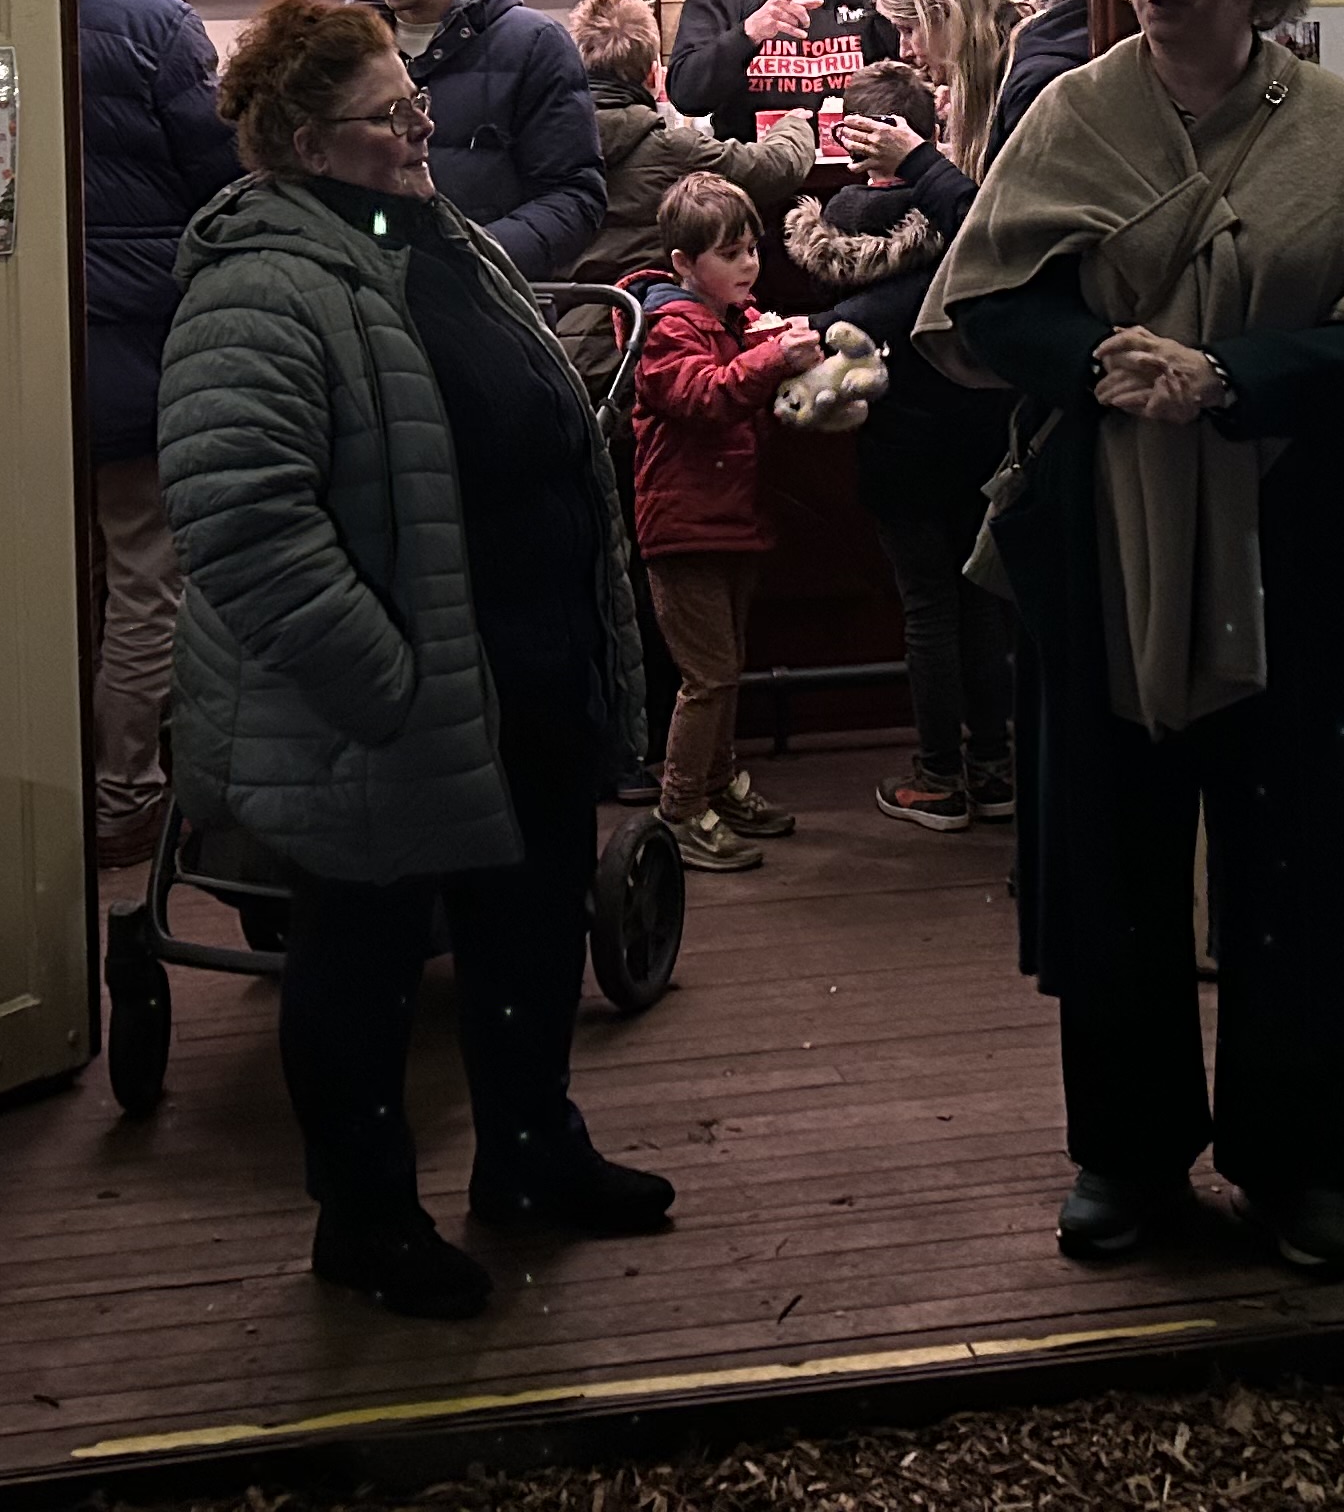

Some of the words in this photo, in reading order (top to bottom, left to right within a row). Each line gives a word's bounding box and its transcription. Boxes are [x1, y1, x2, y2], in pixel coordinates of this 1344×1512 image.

[802, 35, 862, 56] FOUTE
[749, 54, 861, 75] KERSTTRUI
[748, 78, 774, 92] ZIT
[778, 78, 796, 93] IN
[801, 78, 824, 93] DE
